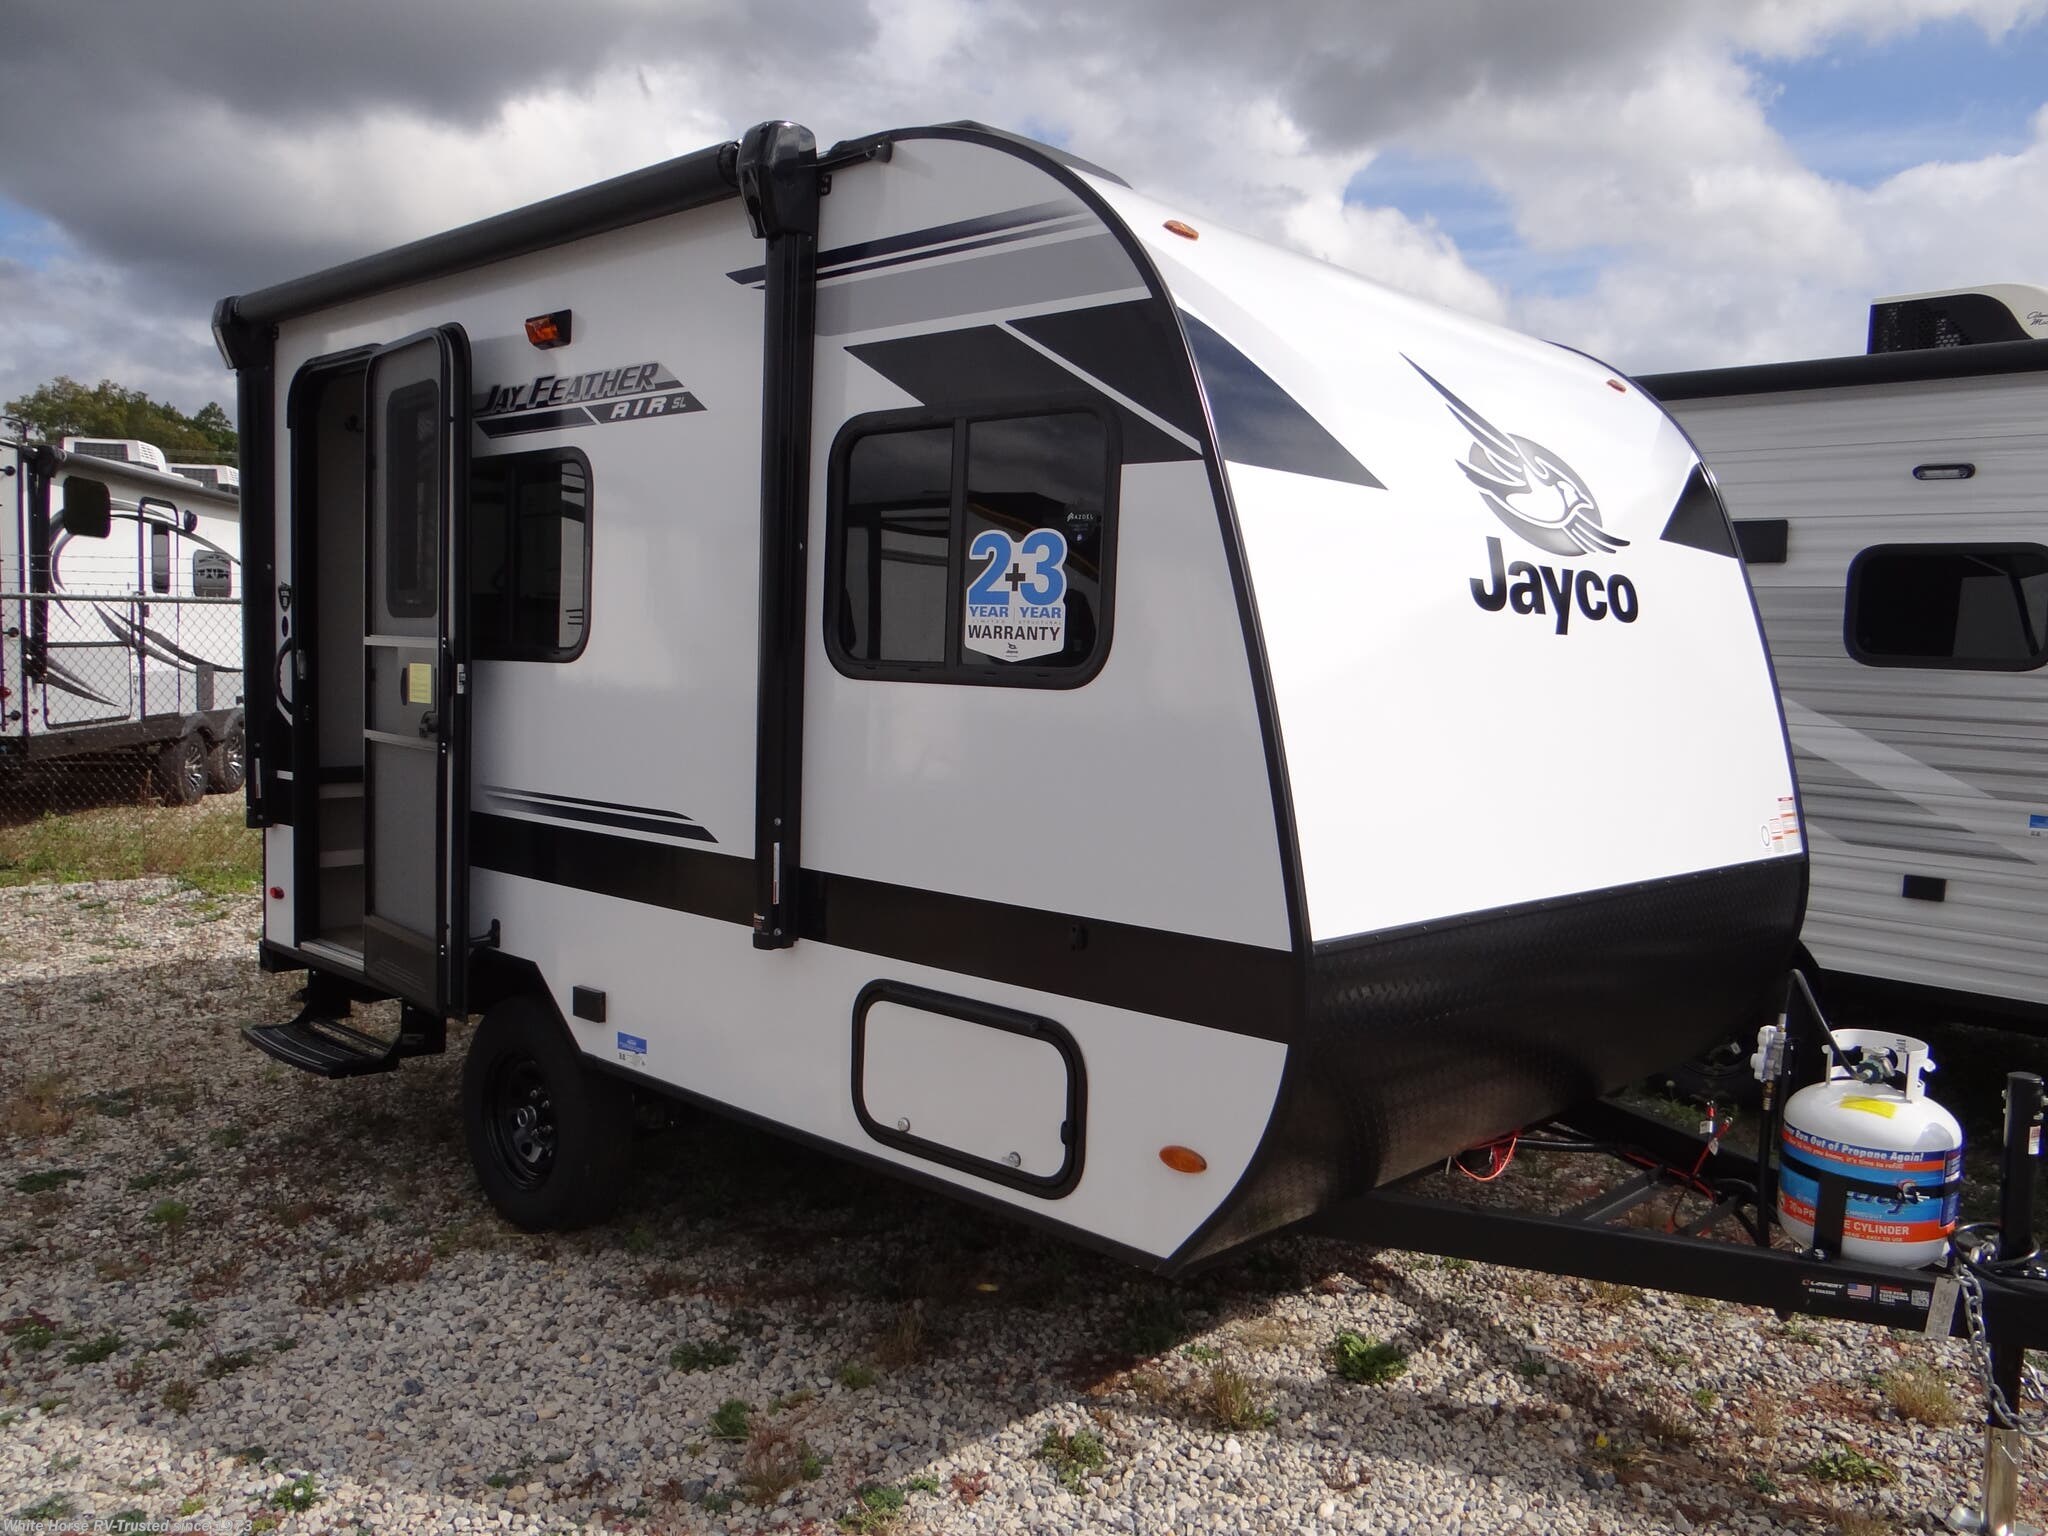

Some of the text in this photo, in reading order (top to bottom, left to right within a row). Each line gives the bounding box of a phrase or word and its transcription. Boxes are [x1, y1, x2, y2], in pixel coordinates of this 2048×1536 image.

[478, 361, 660, 414] JAY FEATHER
[610, 396, 687, 419] AIR SL
[1469, 535, 1639, 635] Jayco
[969, 606, 1062, 618] YEAR YEAR
[967, 624, 1061, 641] WARRANTY
[1810, 1136, 1826, 1148] Out
[1827, 1142, 1840, 1151] of
[1841, 1144, 1888, 1161] Propane
[1889, 1151, 1924, 1163] Again!
[1853, 1221, 1910, 1235] CYLINDER
